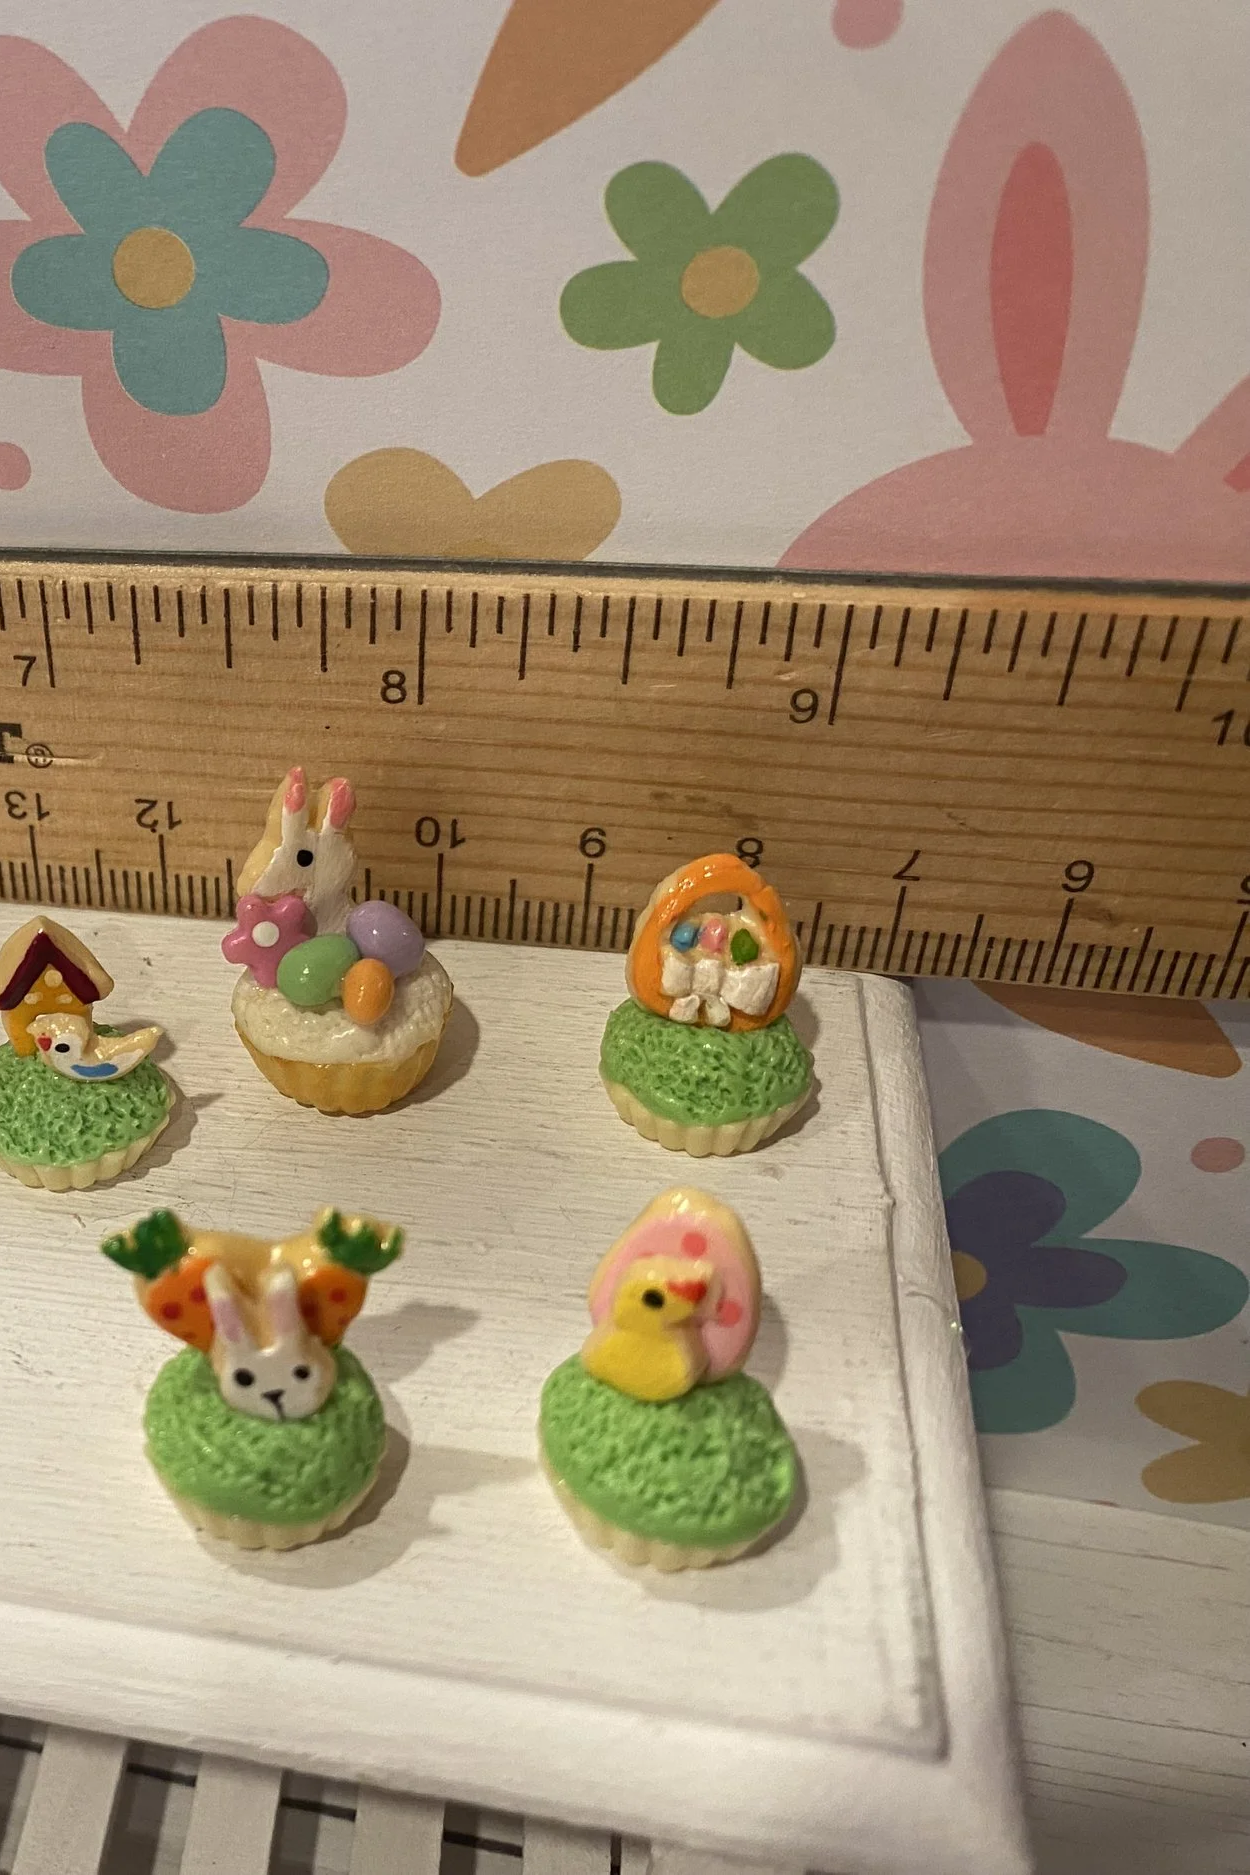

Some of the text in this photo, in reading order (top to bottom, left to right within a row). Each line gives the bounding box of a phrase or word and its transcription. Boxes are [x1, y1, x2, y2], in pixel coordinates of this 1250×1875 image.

[13, 655, 37, 687] 7
[381, 670, 407, 703] 8
[789, 688, 819, 724] 9
[1211, 708, 1250, 747] 1
[4, 791, 50, 822] 13
[135, 798, 182, 830] 12
[415, 816, 466, 850] 10
[579, 828, 607, 864] 9
[736, 837, 764, 869] 8
[893, 849, 921, 882] 7
[1061, 860, 1094, 892] 6
